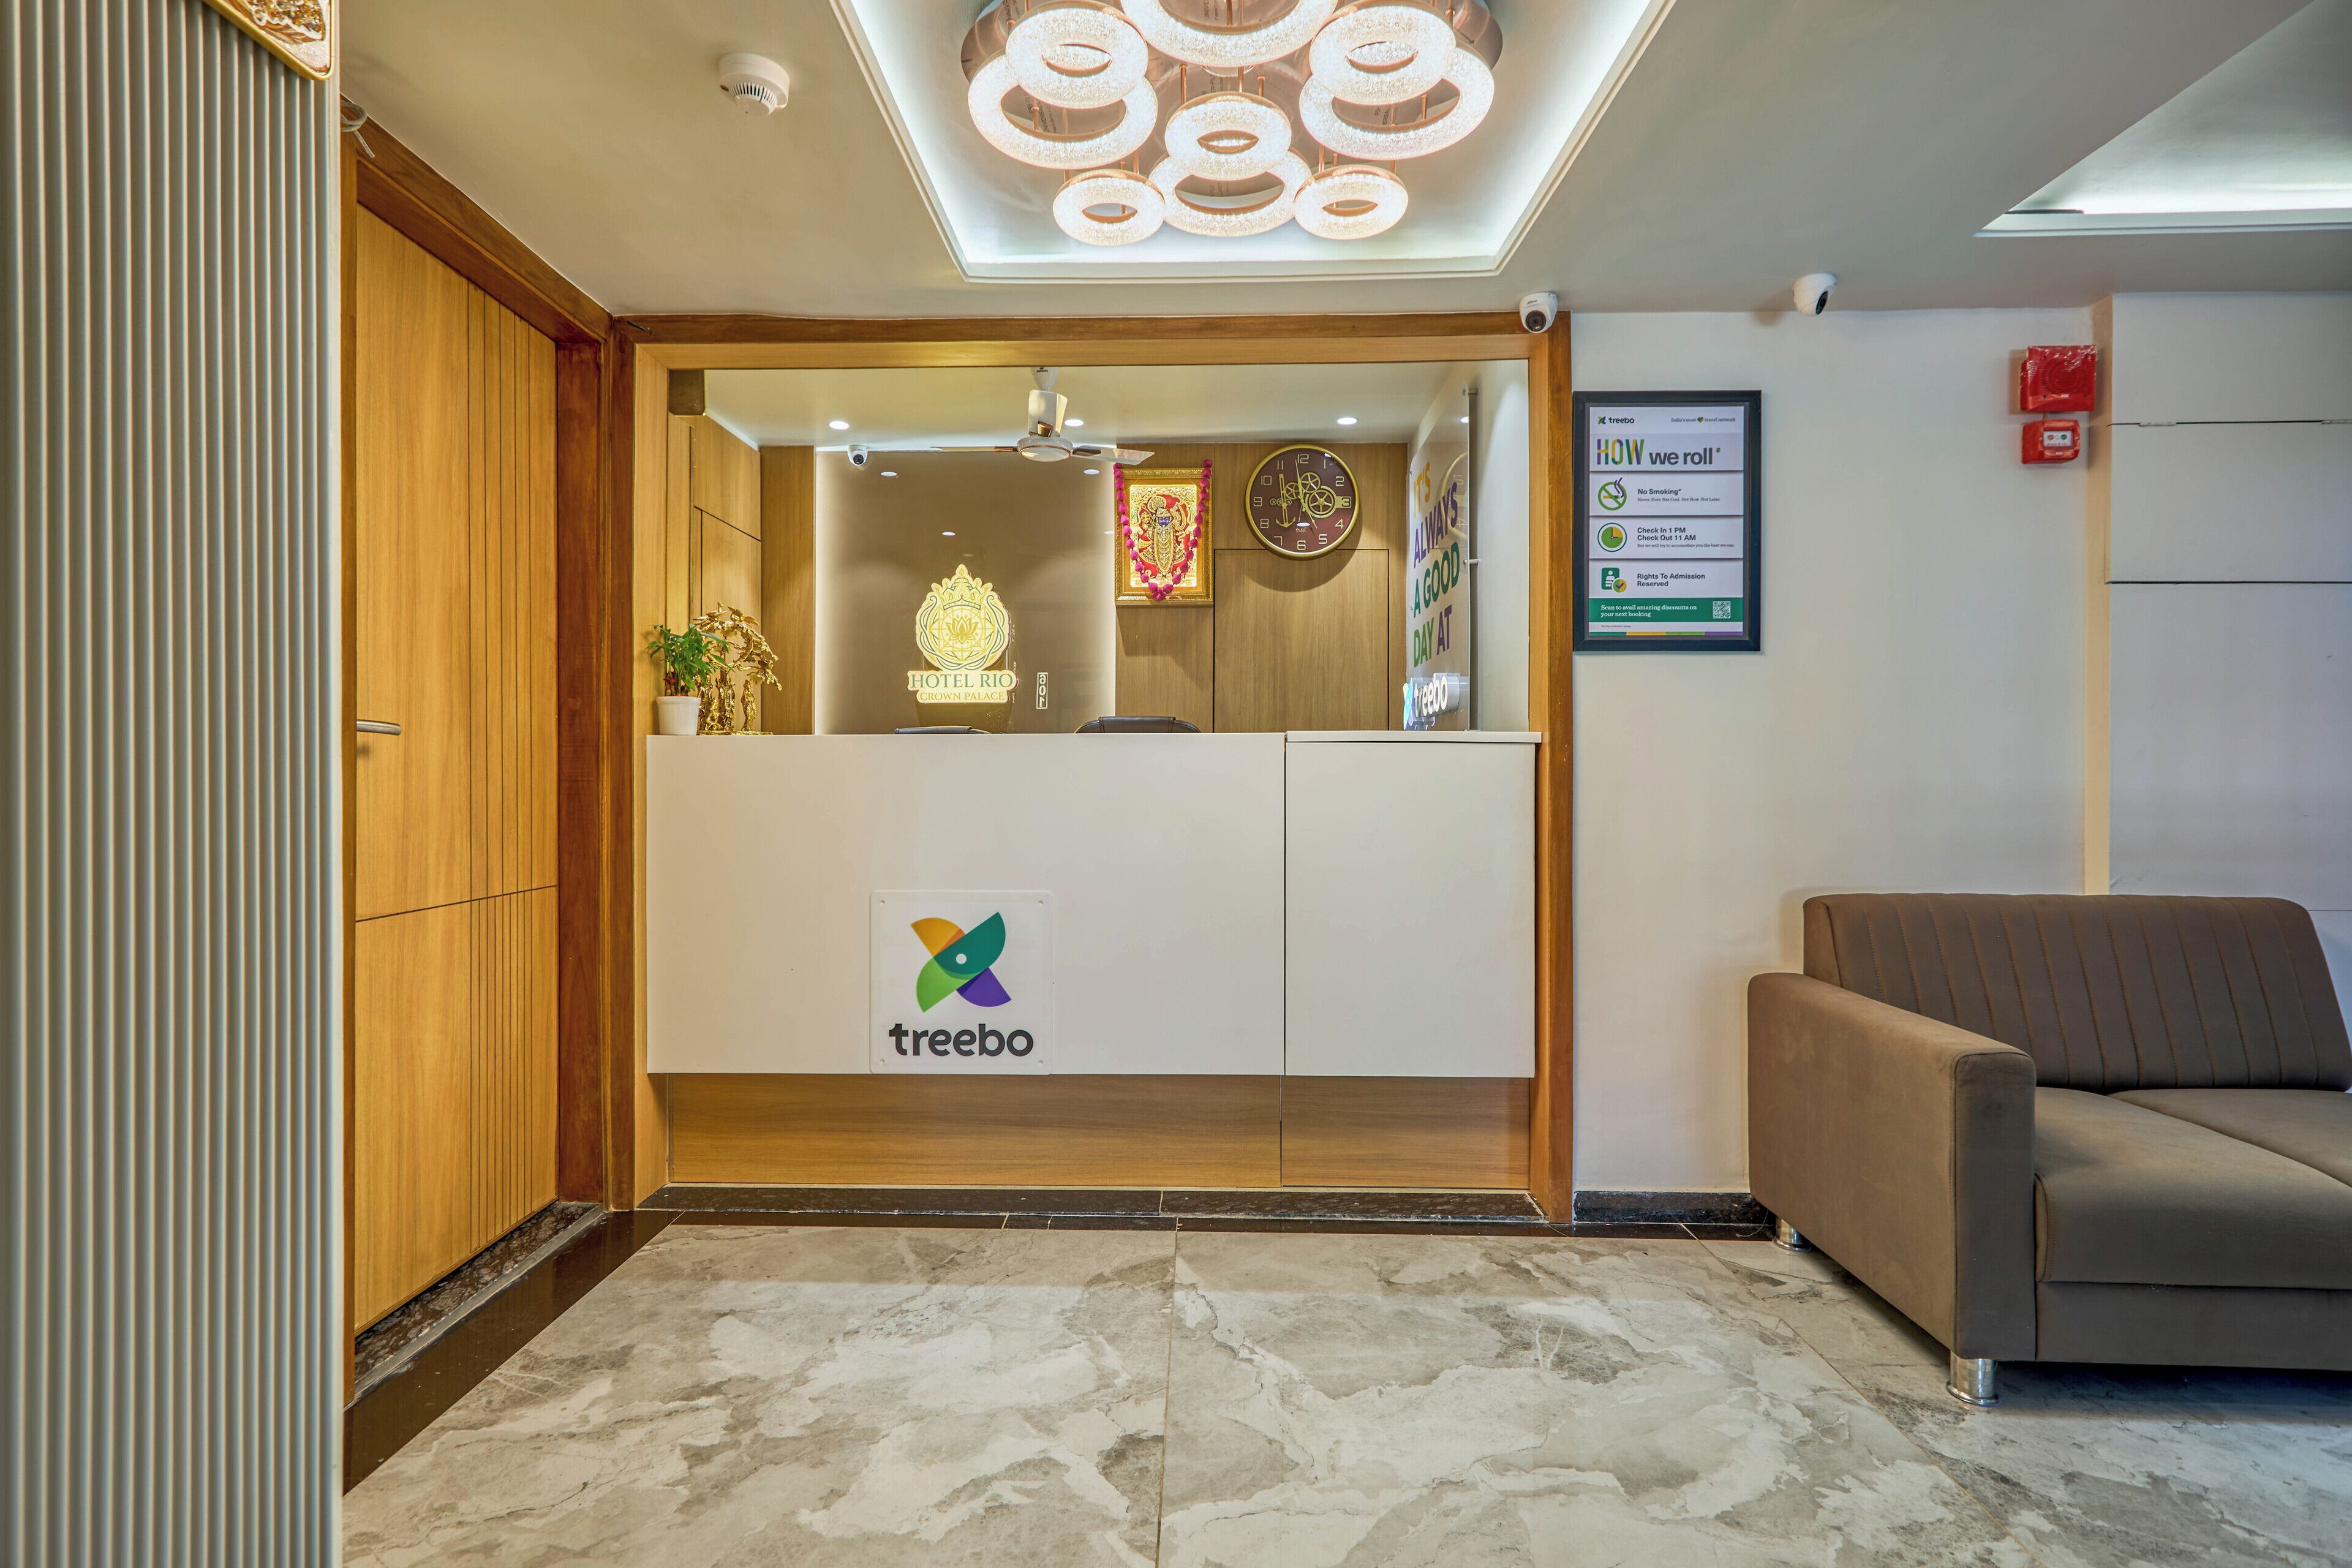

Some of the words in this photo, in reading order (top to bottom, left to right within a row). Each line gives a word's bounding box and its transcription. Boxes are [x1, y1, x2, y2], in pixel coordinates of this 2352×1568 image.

[1597, 439, 1645, 466] HOW
[1649, 452, 1679, 466] we
[1297, 454, 1309, 464] 12
[1277, 460, 1284, 470] 11
[1261, 475, 1272, 485] 10
[1335, 476, 1344, 486] 2
[1413, 461, 1431, 519] IT'S
[1253, 497, 1262, 507] 9
[1341, 498, 1350, 507] 3
[1261, 519, 1269, 529] 8
[1335, 519, 1344, 529] 4
[1414, 481, 1458, 568] ALWAYS
[1273, 536, 1283, 546] 7
[1319, 534, 1328, 545] 5
[1297, 540, 1306, 551] 6
[1414, 578, 1420, 619] A
[1423, 541, 1460, 609] GOOD
[1414, 617, 1434, 668] DAY
[1436, 604, 1452, 655] AT
[911, 674, 974, 688] HOTEL
[979, 673, 1013, 688] RIO
[920, 692, 961, 701] CROWN
[965, 692, 1005, 701] PALACE
[1414, 673, 1448, 718] treebo
[889, 1023, 1034, 1057] treebo
